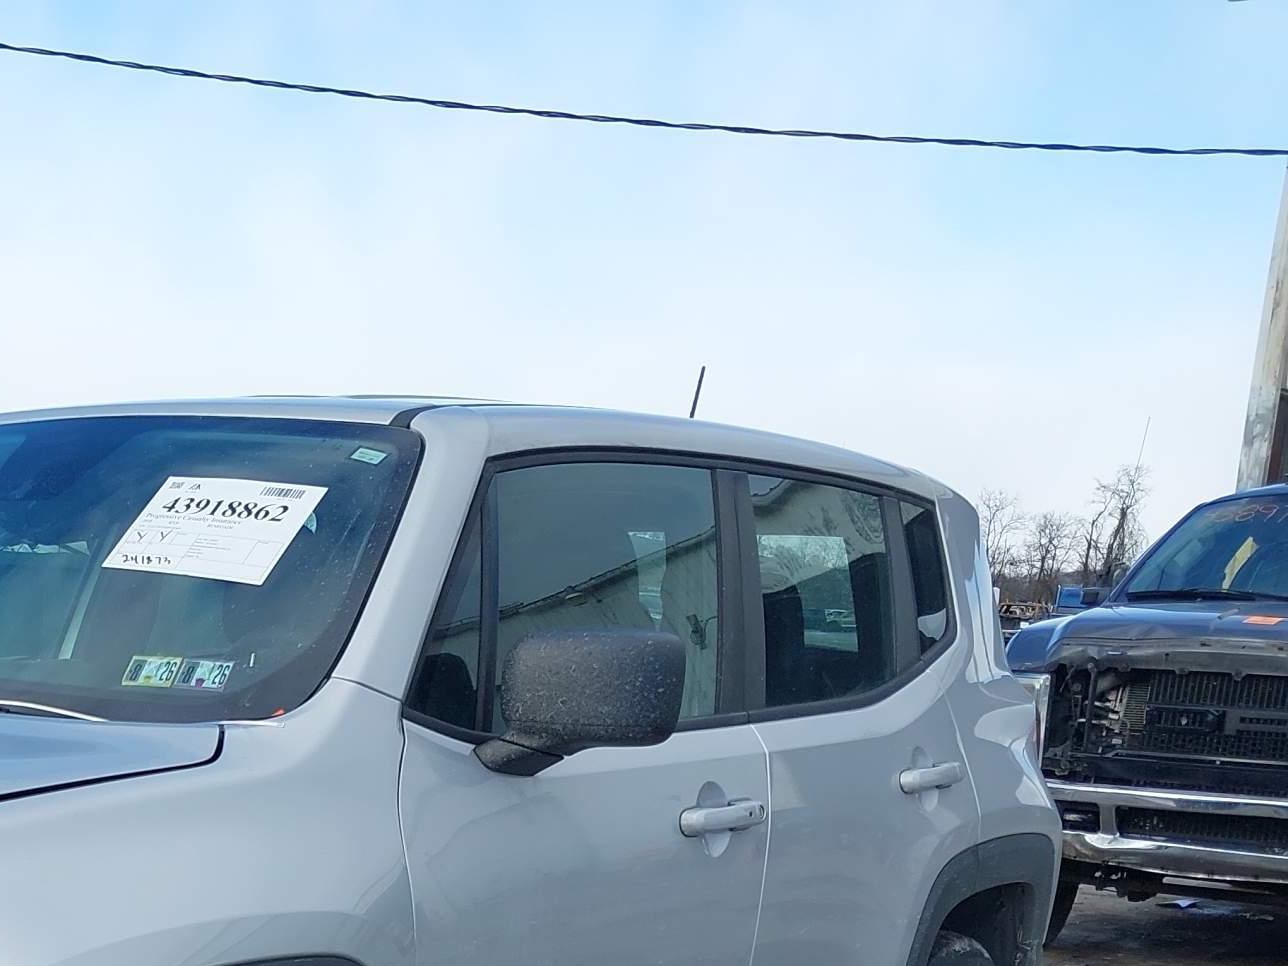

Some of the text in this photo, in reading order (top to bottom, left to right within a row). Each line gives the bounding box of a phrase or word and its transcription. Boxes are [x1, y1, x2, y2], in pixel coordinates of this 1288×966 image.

[162, 496, 289, 522] 43918862
[129, 661, 177, 682] 8 26
[182, 664, 231, 685] 8 26
